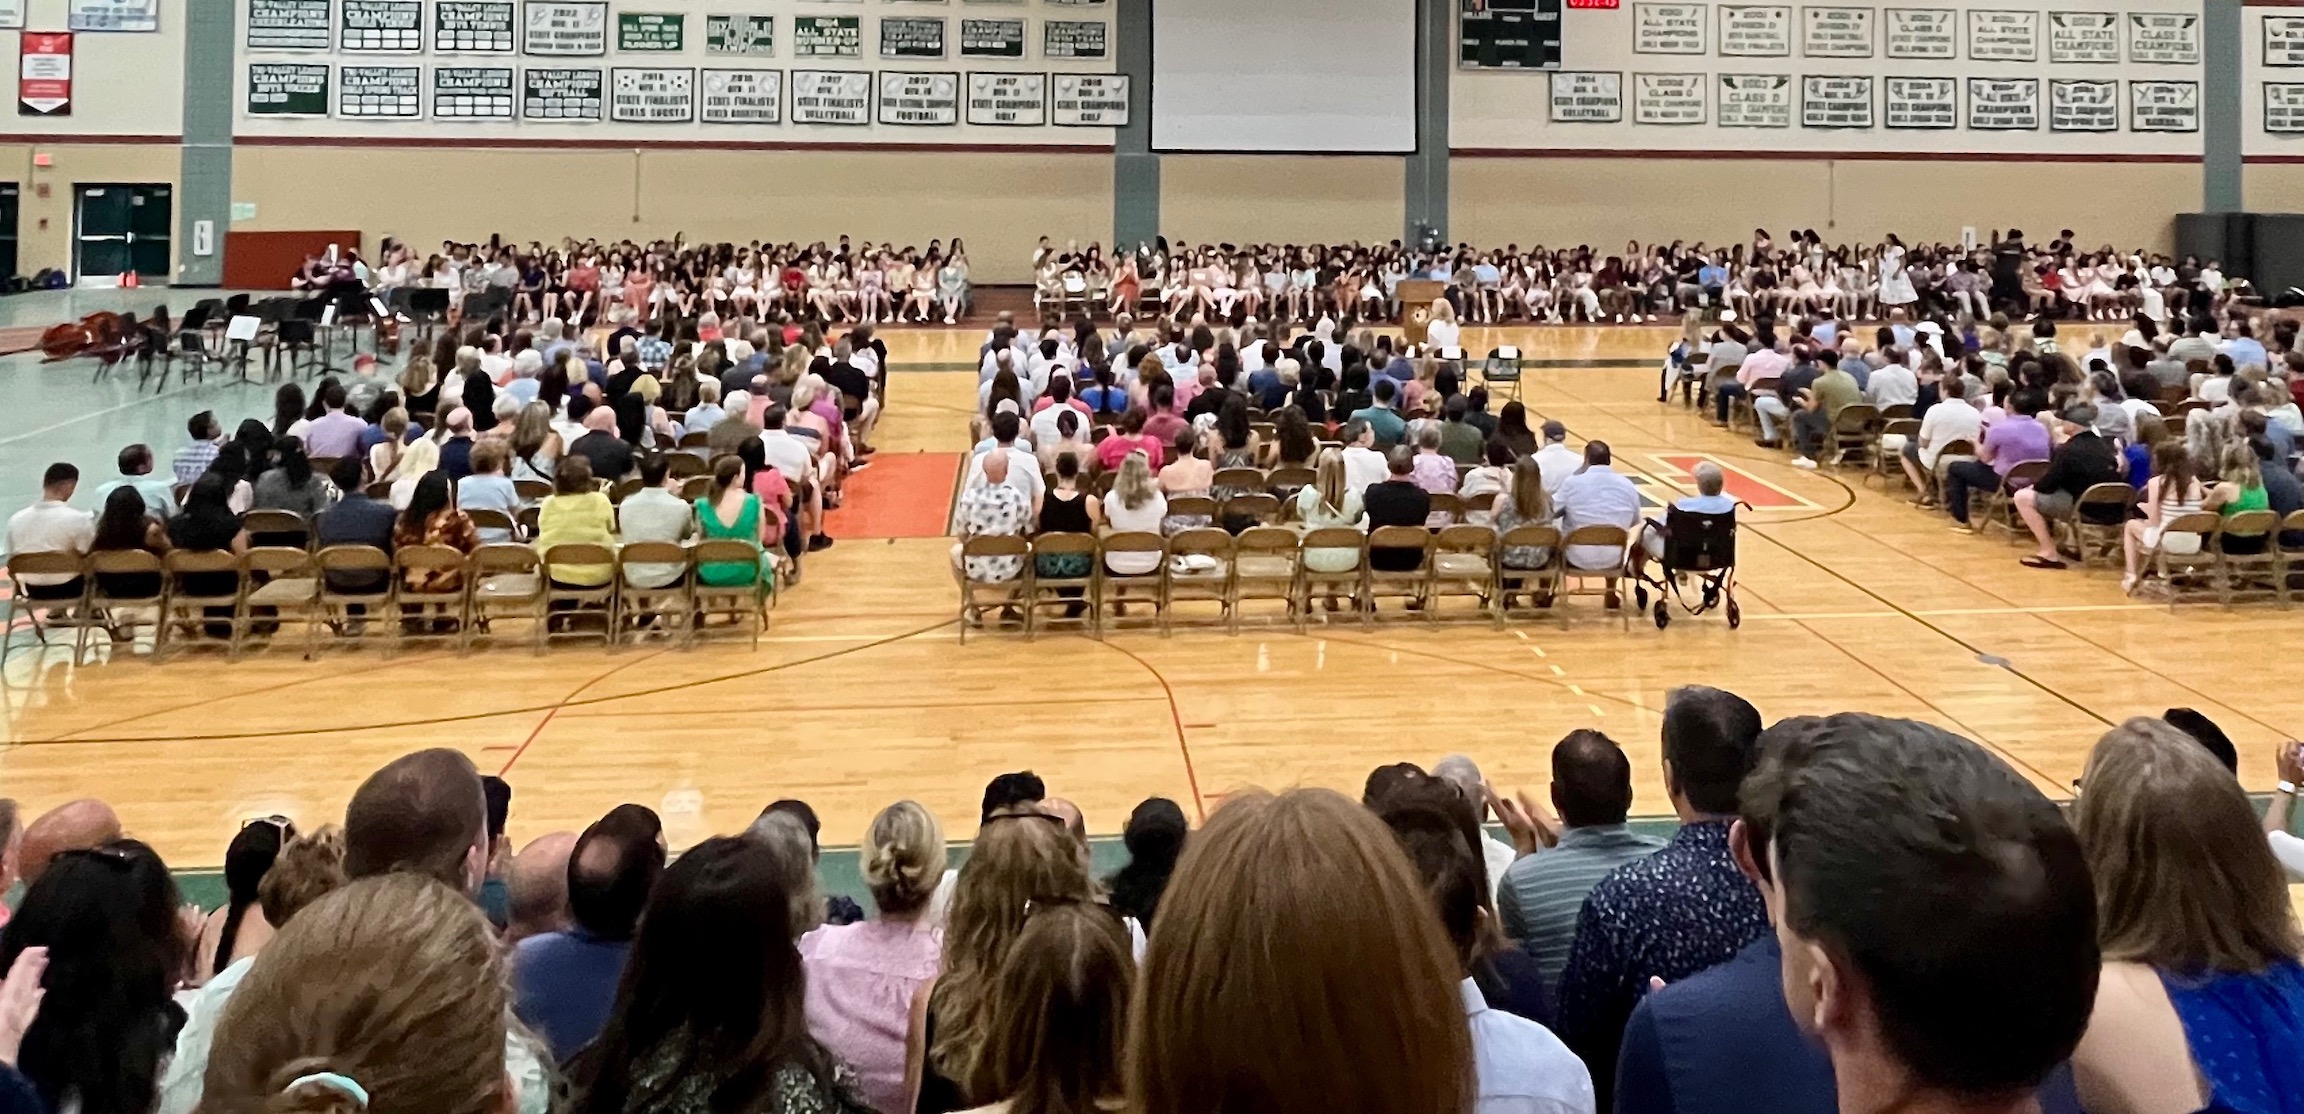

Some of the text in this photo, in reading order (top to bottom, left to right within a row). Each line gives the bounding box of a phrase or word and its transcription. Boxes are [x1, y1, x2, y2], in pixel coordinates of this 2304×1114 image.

[253, 9, 326, 18] CHAMPIONS
[346, 10, 417, 20] CHAMPIONS
[440, 11, 511, 21] CHAMPIONS
[1666, 19, 1697, 27] STATE
[796, 27, 858, 37] ALL STATE
[1642, 29, 1698, 37] CHAMPIONS
[2001, 26, 2029, 35] STATE
[2054, 30, 2114, 40] ALL STATE
[2141, 30, 2176, 40] CLASS
[1976, 36, 2031, 45] CHAMPIONS
[2055, 41, 2114, 50] CHAMPIONS
[2134, 41, 2194, 51] CHAMPIONS
[253, 75, 325, 84] CHAMPIONS
[344, 76, 416, 86] CHAMPIONS
[438, 78, 509, 87] CHAMPIONS
[528, 79, 599, 89] CHAMPIONS
[820, 76, 842, 84] 2017
[996, 78, 1018, 86] 2017
[1648, 89, 1683, 97] CLASS
[1729, 92, 1780, 102] CLASS D
[616, 95, 689, 105] STATE FINALISTS
[707, 96, 775, 106] STATE FINALISTS
[797, 97, 865, 108] STATE FINALISTS
[972, 99, 1041, 109] STATE CHAMPIONS
[1057, 100, 1126, 110] STATE CHAMPIONS
[1554, 96, 1618, 106] STATE CHAMPIONS
[619, 107, 646, 117] GIRLS
[804, 109, 856, 120] VOLLEYBALL
[1562, 109, 1610, 117] VOLLEYBALL
[1976, 105, 2032, 114] CHAMPIONS
[896, 110, 938, 120] FOOTBALL
[995, 112, 1017, 120] GOLF
[1080, 113, 1101, 121] GOLF
